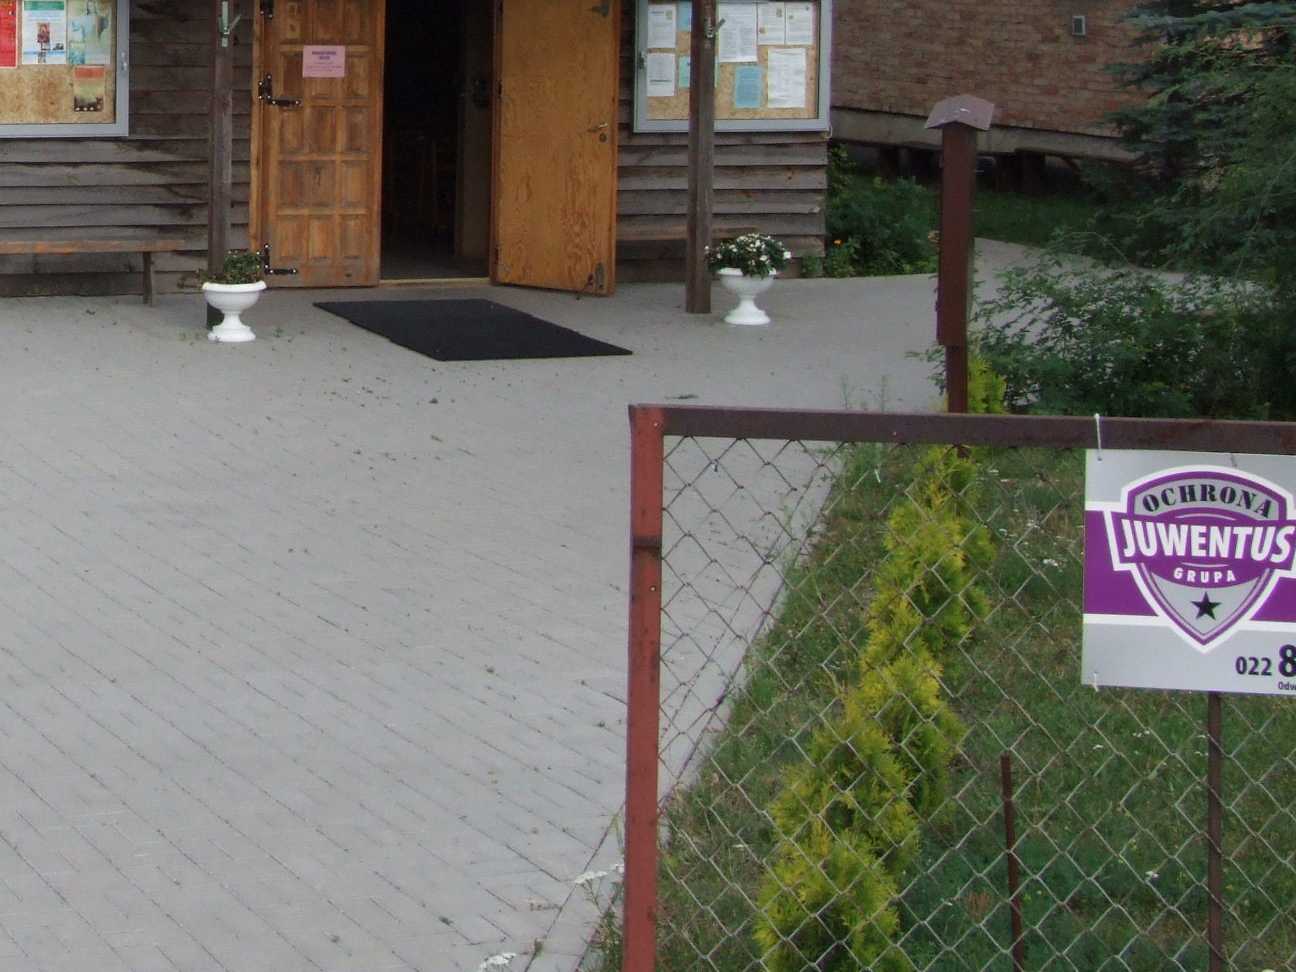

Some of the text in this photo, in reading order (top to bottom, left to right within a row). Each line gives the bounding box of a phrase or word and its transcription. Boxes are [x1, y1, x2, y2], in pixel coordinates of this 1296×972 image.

[1142, 484, 1272, 518] OCHRONA
[1121, 518, 1296, 563] JUWENTUS
[1173, 567, 1236, 583] GRUPA
[1235, 656, 1272, 676] 022
